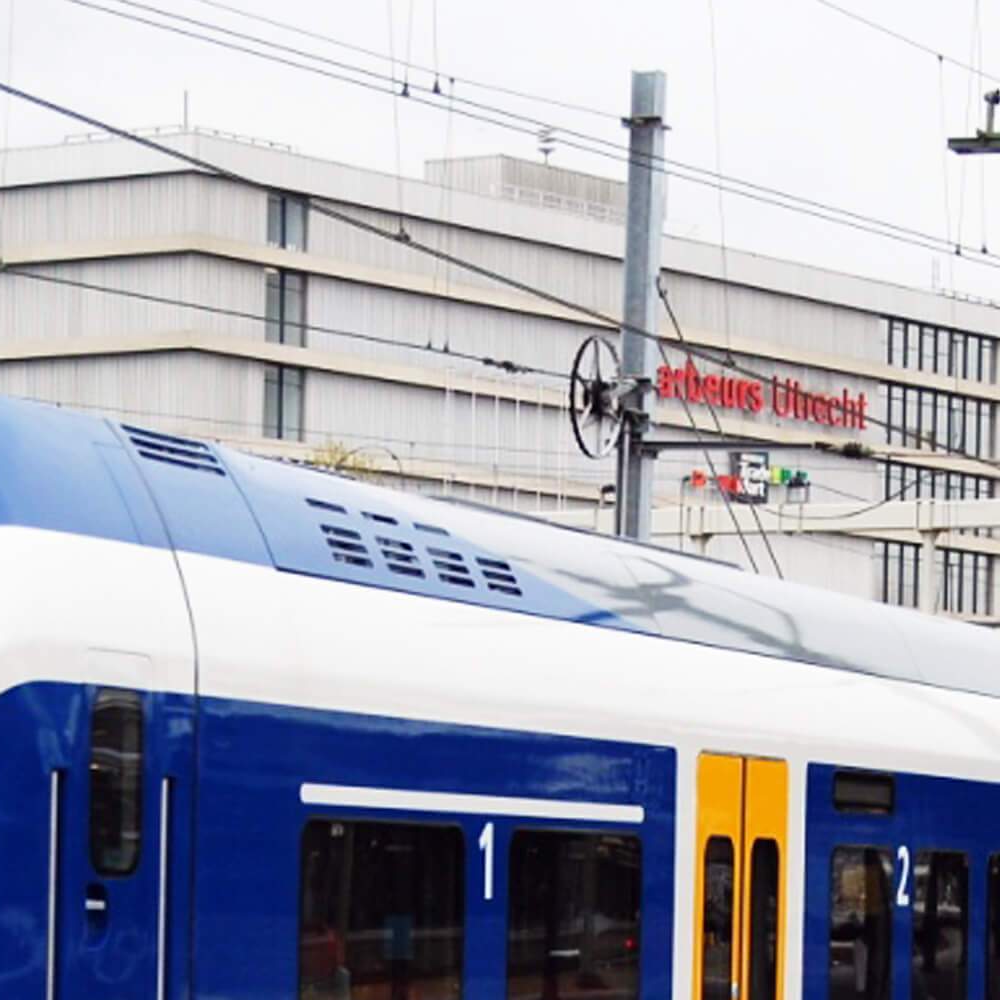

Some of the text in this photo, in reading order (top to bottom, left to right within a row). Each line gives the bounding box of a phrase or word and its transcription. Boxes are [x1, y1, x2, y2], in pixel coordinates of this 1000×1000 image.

[773, 375, 868, 430] Utrecht
[479, 821, 495, 900] 1
[897, 845, 910, 907] 2
